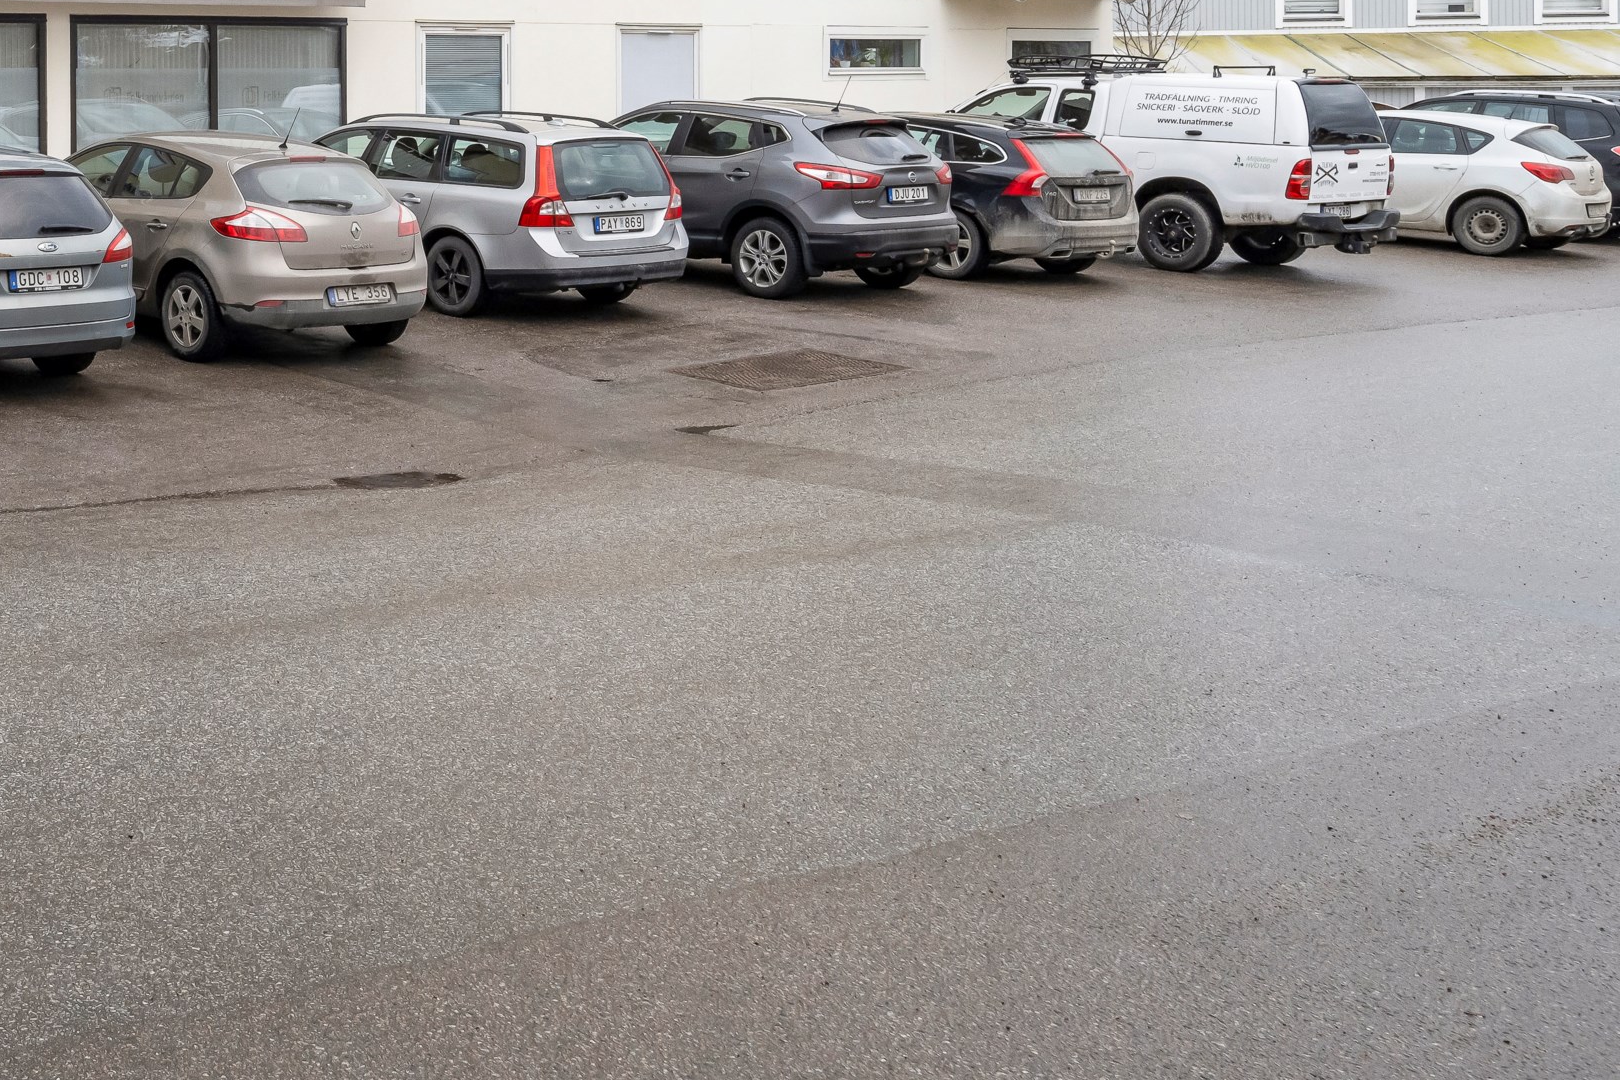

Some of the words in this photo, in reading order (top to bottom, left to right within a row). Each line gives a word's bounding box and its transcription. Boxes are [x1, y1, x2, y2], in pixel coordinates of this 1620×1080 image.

[1218, 95, 1258, 105] TIMRING
[1136, 102, 1176, 111] SNICKERI
[1182, 103, 1224, 113] SÅGVERK
[1231, 106, 1261, 115] SLÖJD
[1157, 118, 1234, 127] www.tunatimmer.se
[894, 188, 910, 199] DJU
[911, 187, 925, 198] 201
[1094, 189, 1108, 199] 225
[596, 202, 648, 210] VOLVO
[600, 218, 619, 229] PAY
[624, 216, 642, 228] 869
[18, 271, 45, 287] GDC
[56, 269, 80, 284] 108
[336, 287, 360, 302] LYE
[366, 285, 388, 299] 356
